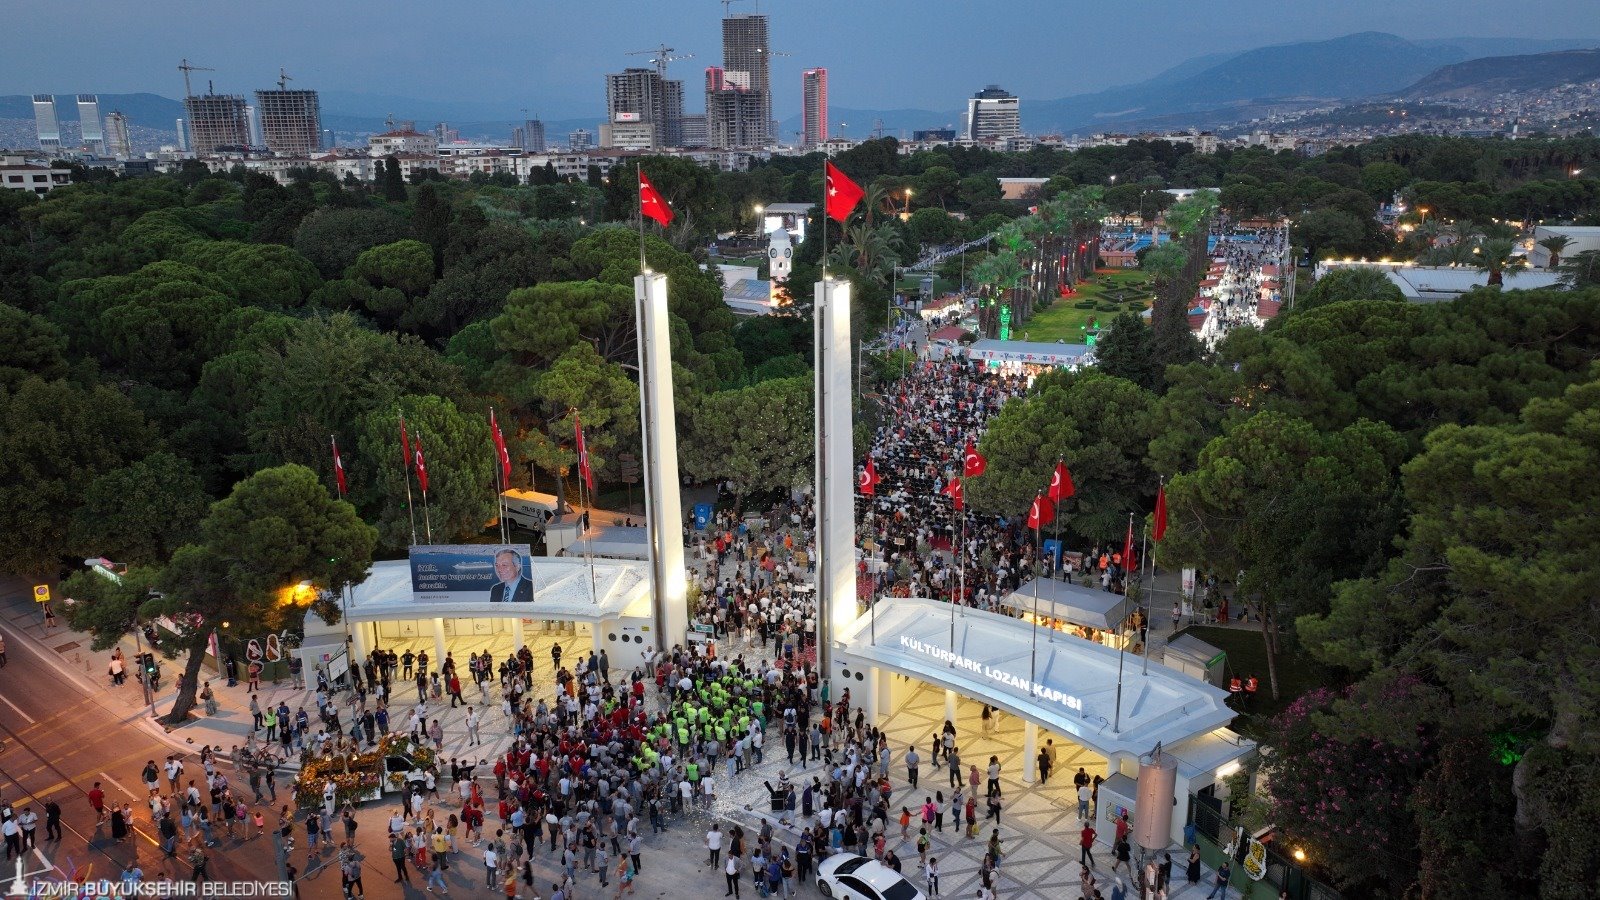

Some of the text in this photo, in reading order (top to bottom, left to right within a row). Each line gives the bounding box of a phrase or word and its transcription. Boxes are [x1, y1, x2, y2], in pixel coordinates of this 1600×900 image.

[900, 635, 1081, 711] KÜLTÜRPARK LOZAN KAPISI
